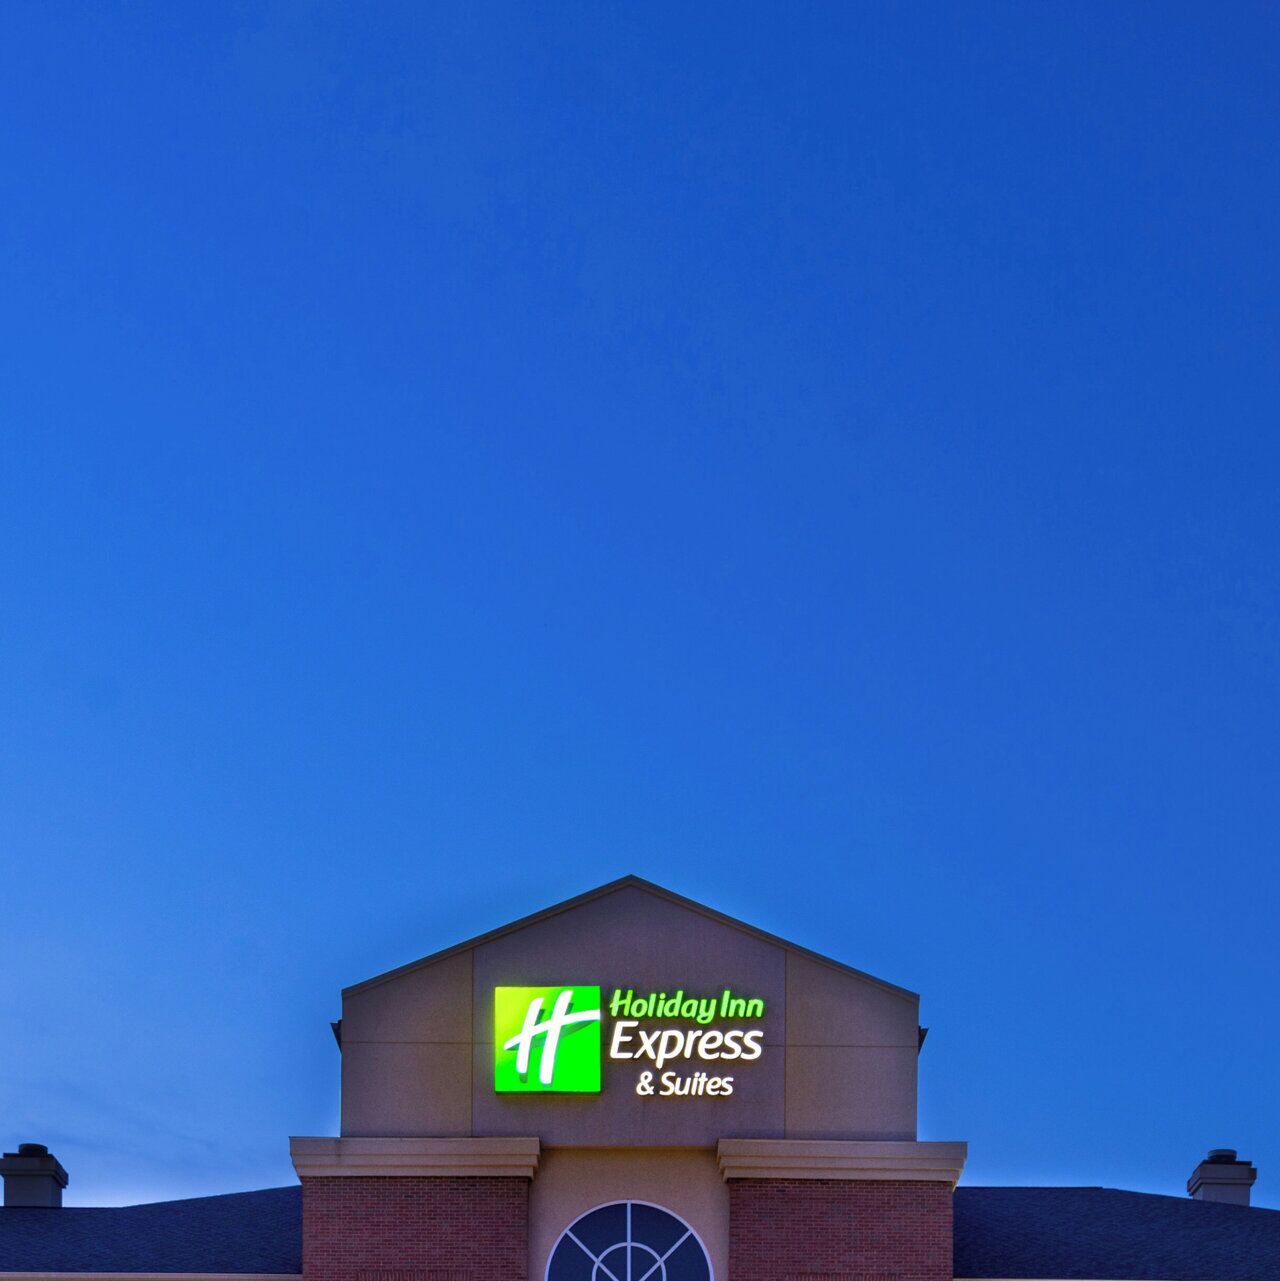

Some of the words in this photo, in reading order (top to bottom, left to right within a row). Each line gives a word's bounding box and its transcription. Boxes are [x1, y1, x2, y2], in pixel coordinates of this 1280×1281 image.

[609, 989, 716, 1024] Holiday
[720, 990, 764, 1018] Inn
[609, 1020, 764, 1069] Express
[635, 1071, 655, 1096] &
[659, 1071, 734, 1096] Suites
